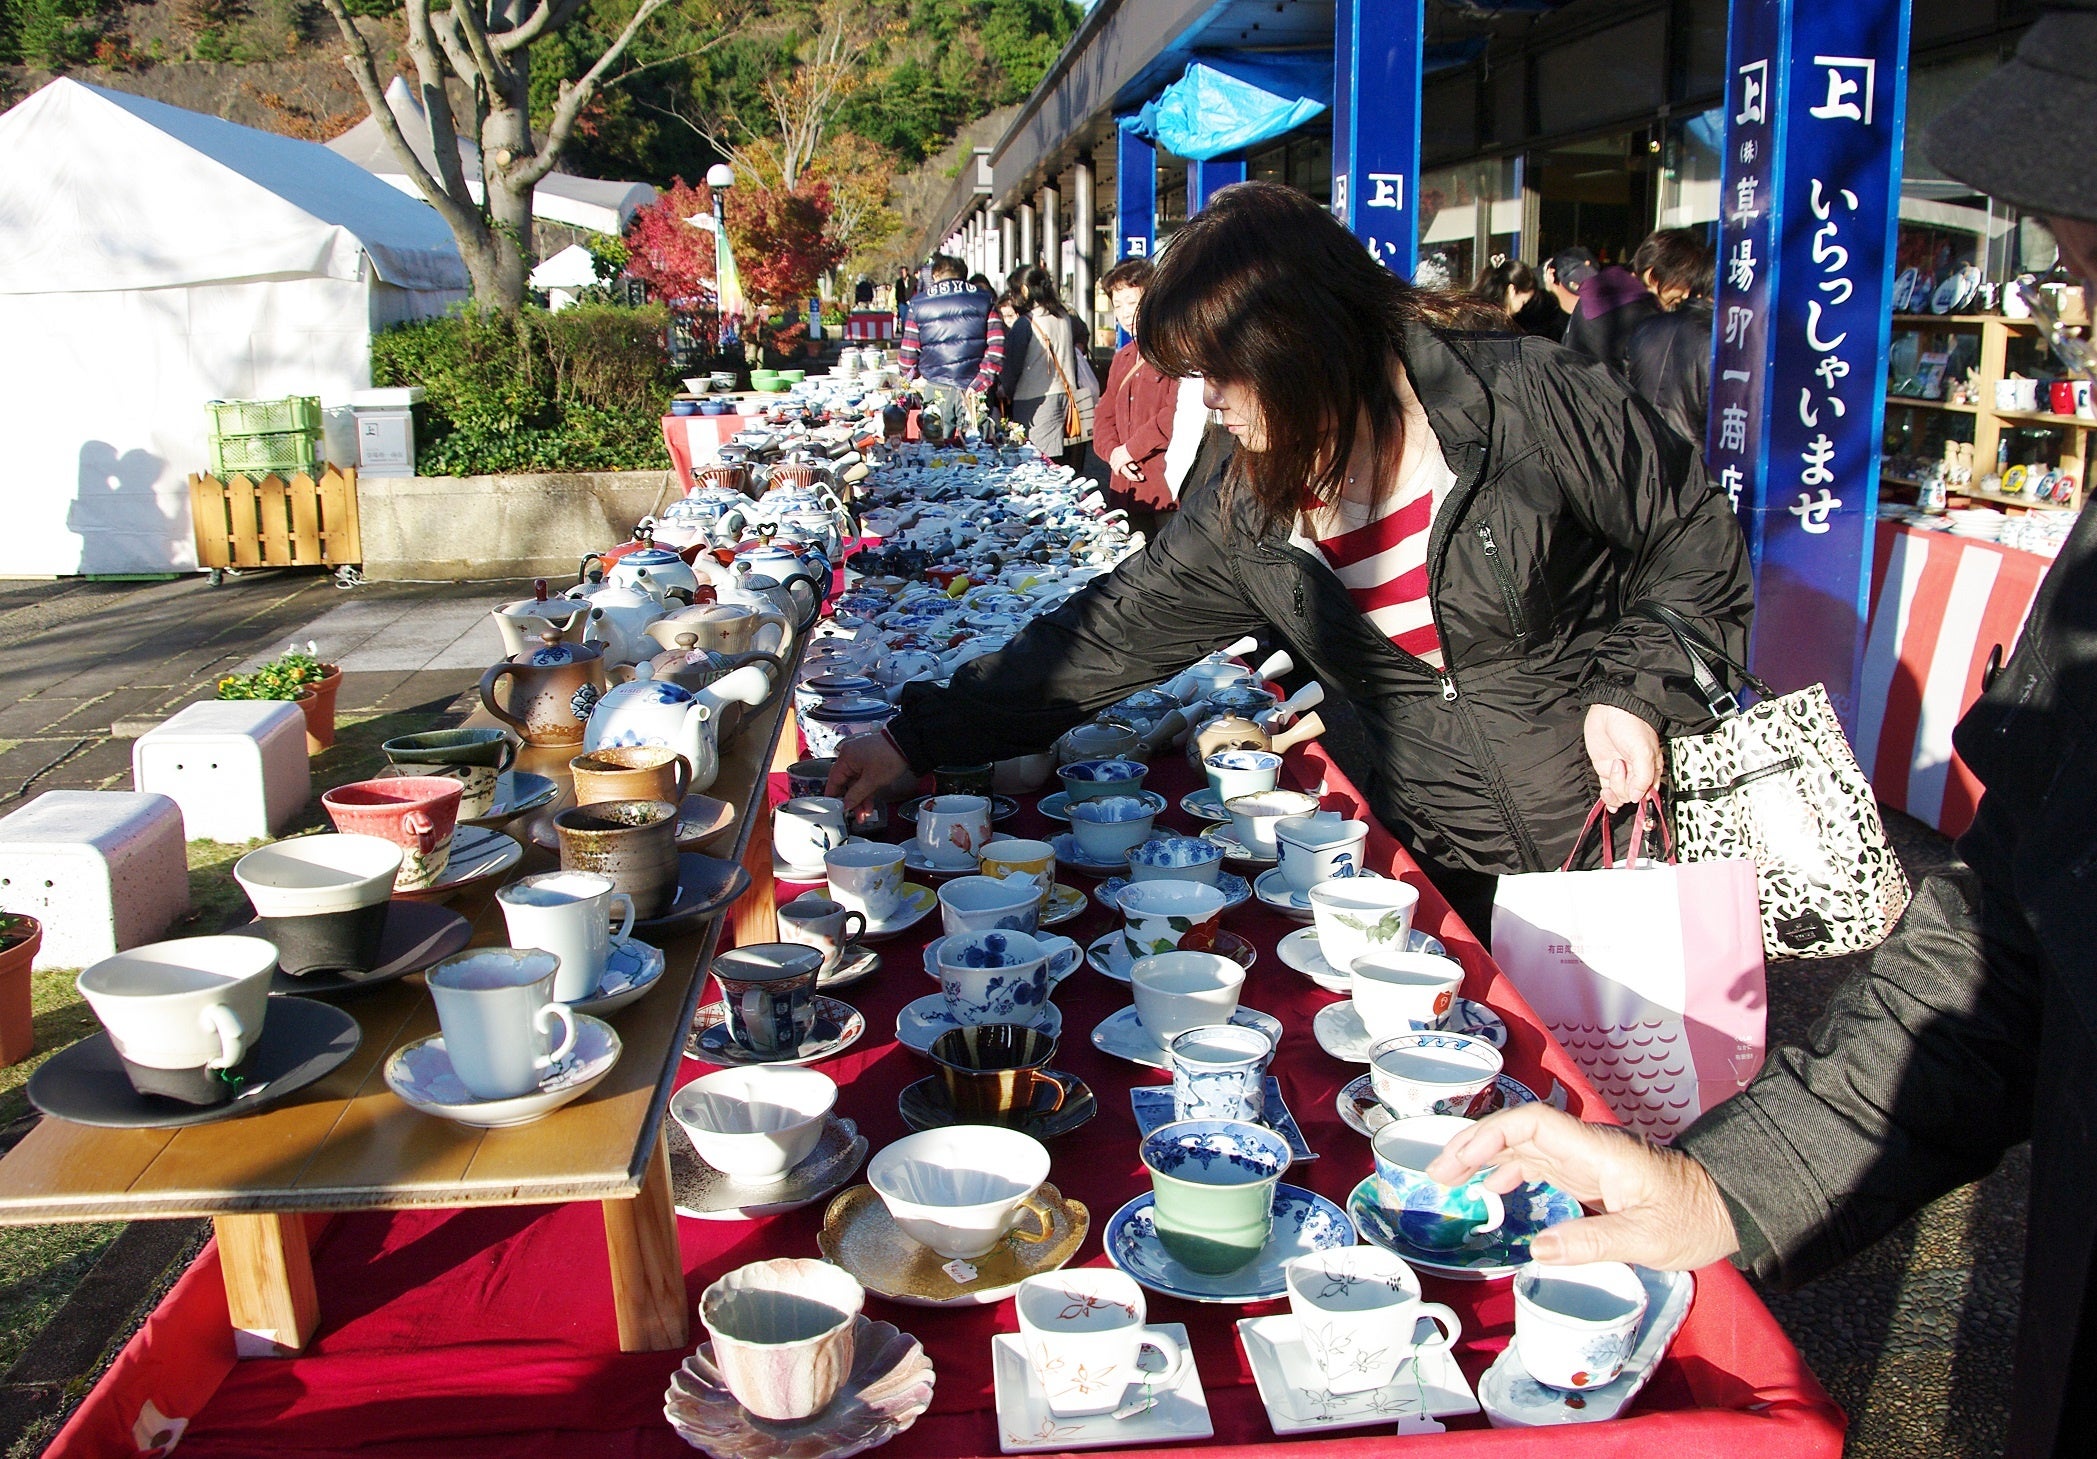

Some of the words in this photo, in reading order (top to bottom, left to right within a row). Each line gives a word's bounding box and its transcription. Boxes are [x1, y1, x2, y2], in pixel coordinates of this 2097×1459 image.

[1810, 56, 1876, 125] 上
[1788, 178, 1859, 534] いらっしゃいませ
